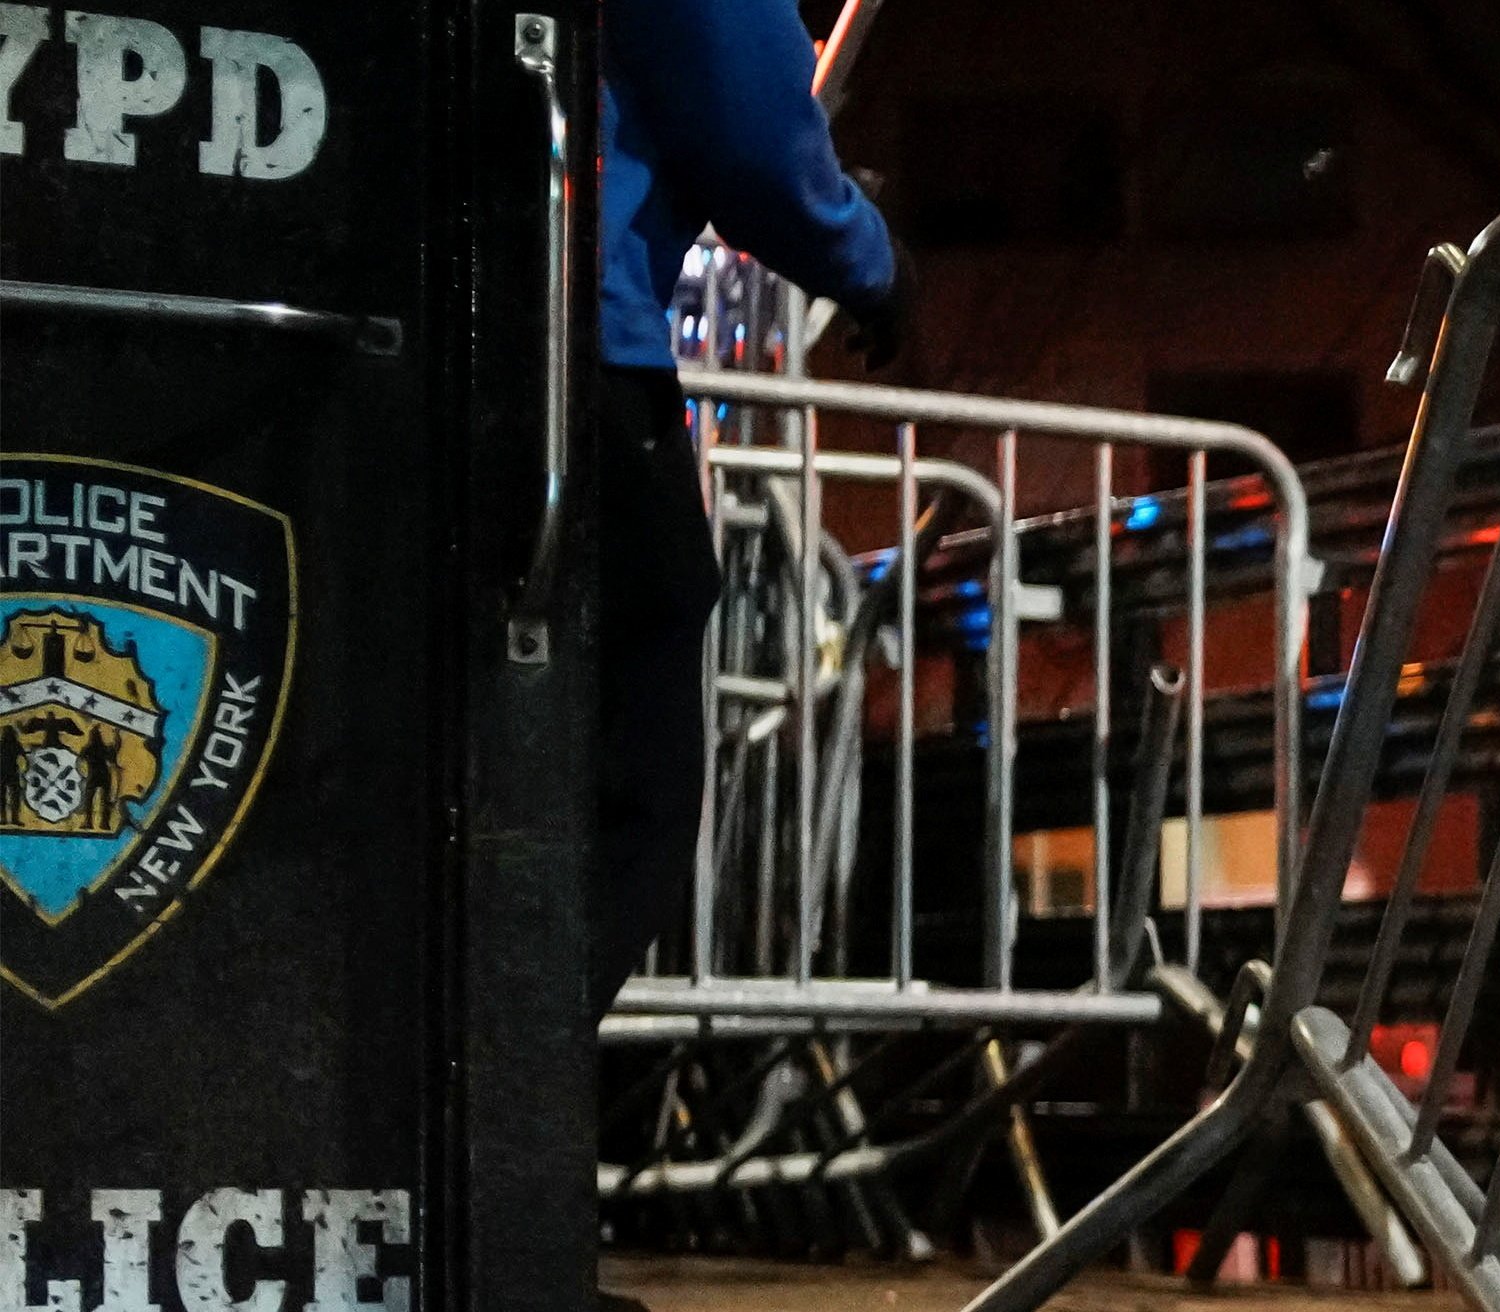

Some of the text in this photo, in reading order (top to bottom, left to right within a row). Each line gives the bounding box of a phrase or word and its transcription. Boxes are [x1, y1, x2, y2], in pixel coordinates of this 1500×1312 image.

[0, 532, 257, 630] RTMENT
[115, 672, 262, 912] NEW YORK
